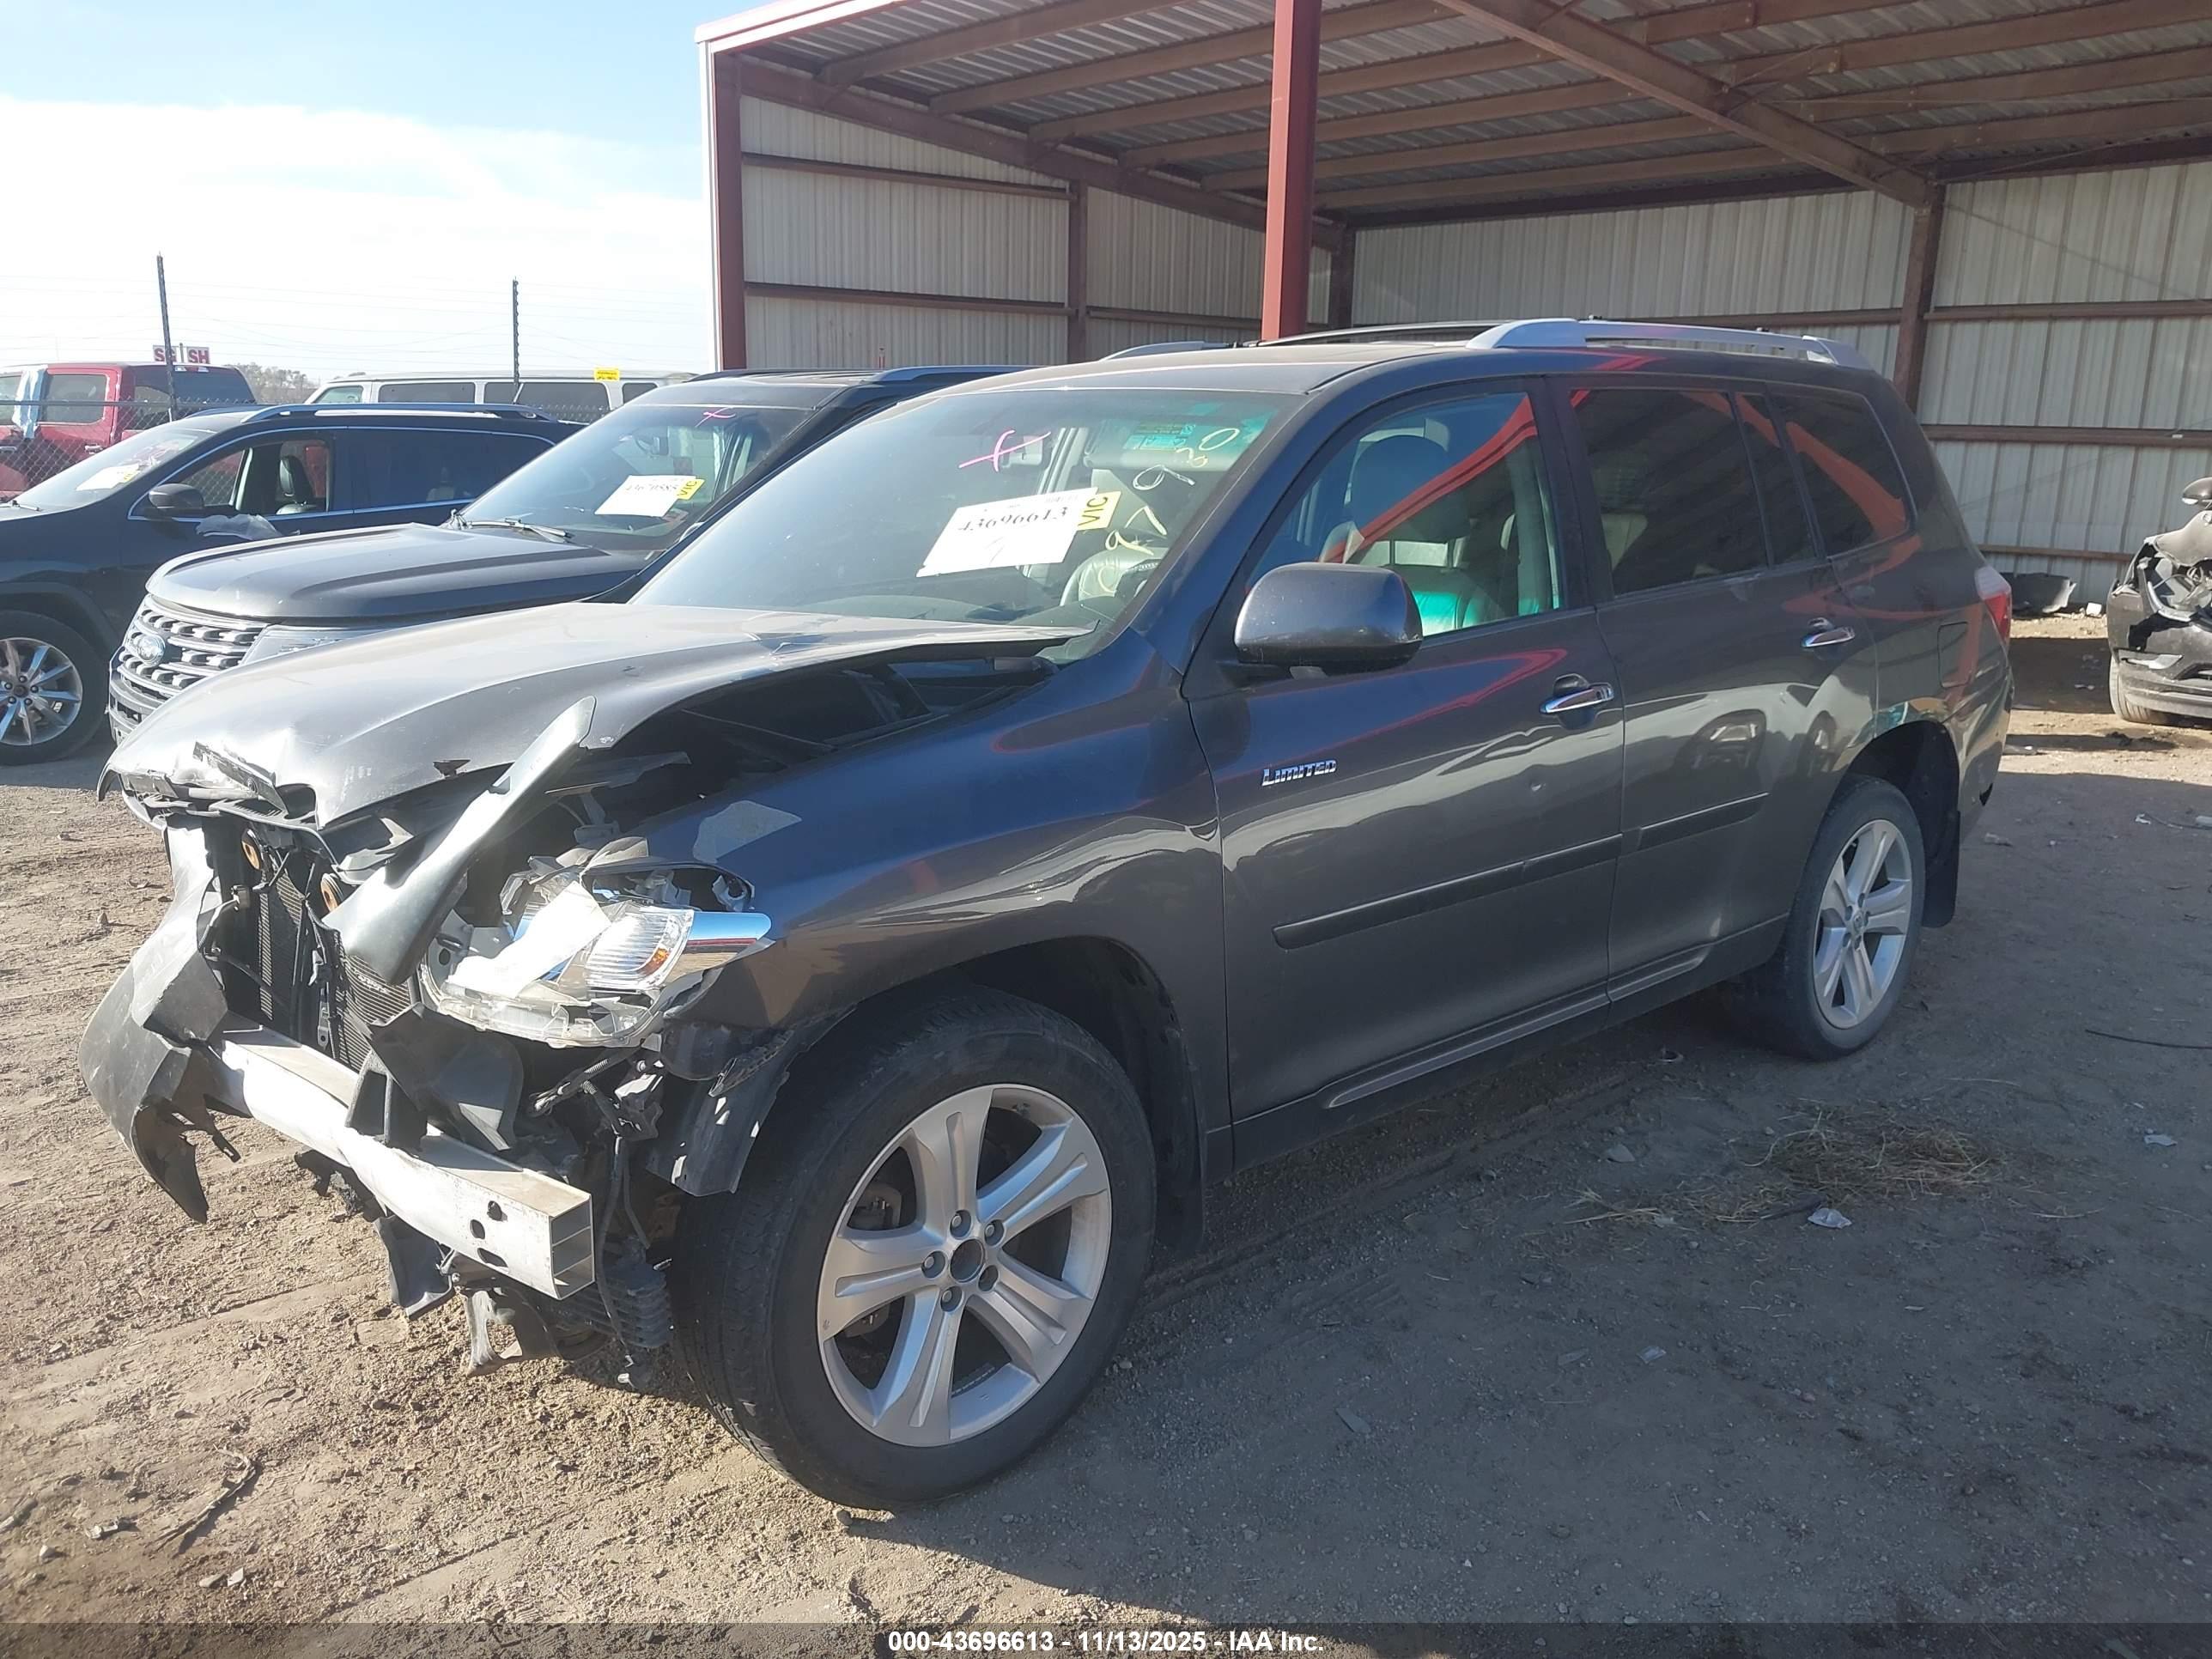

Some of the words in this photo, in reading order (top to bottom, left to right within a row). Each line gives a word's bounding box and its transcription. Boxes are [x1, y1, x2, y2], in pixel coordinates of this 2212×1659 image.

[188, 349, 210, 364] SH
[677, 481, 698, 496] VIC
[1077, 496, 1109, 526] VIC
